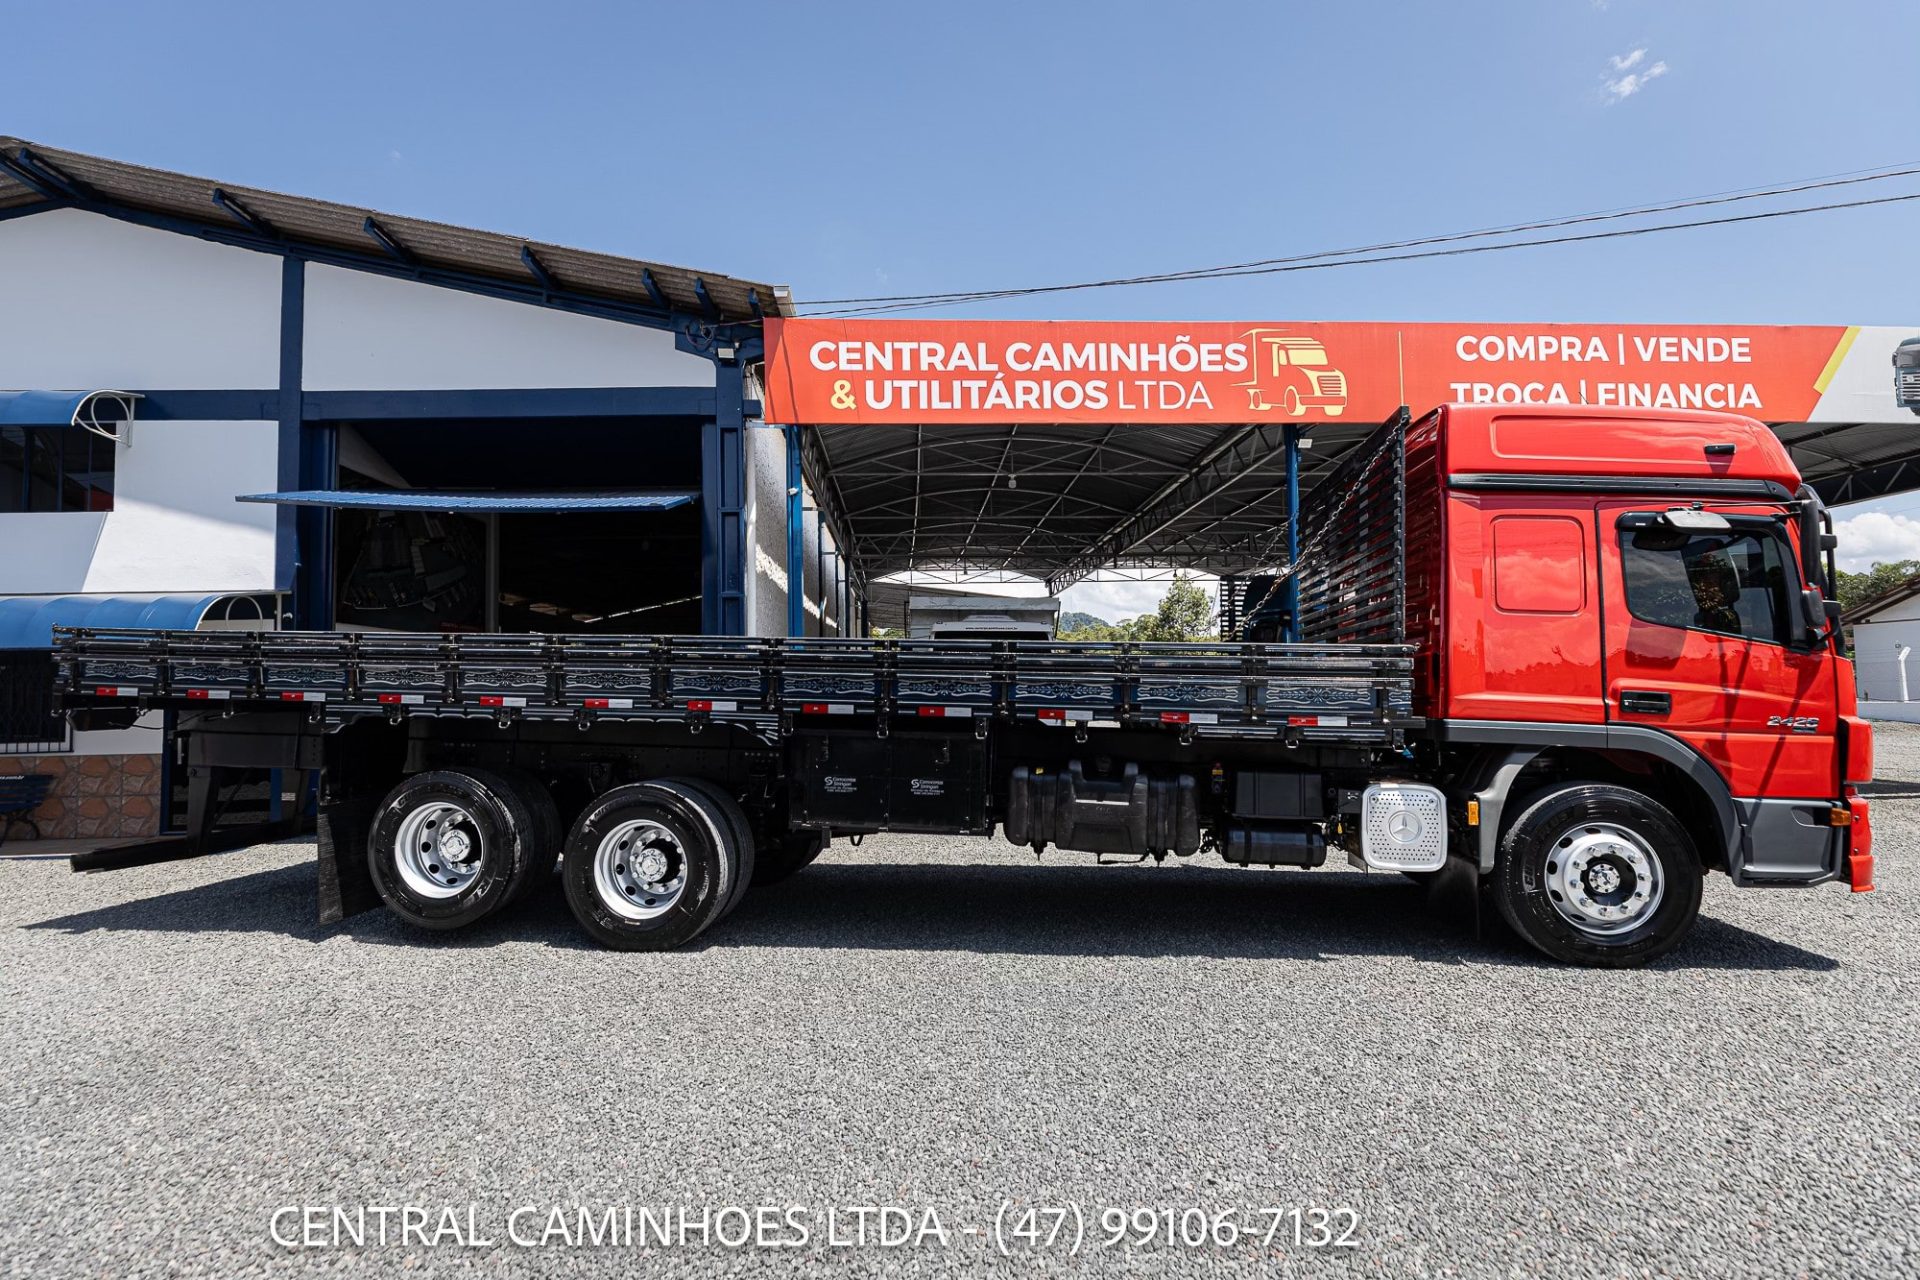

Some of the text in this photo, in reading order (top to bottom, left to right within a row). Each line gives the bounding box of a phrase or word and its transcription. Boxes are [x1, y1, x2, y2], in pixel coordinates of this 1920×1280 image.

[810, 335, 1248, 372] CENTRAL CAMINHÕES
[1456, 335, 1610, 362] COMPRA
[1634, 337, 1751, 362] VENDE
[831, 372, 1213, 409] & UTILITÁRIOS LTDA
[1450, 382, 1570, 404] TROCA
[1597, 383, 1763, 409] FINANCIA
